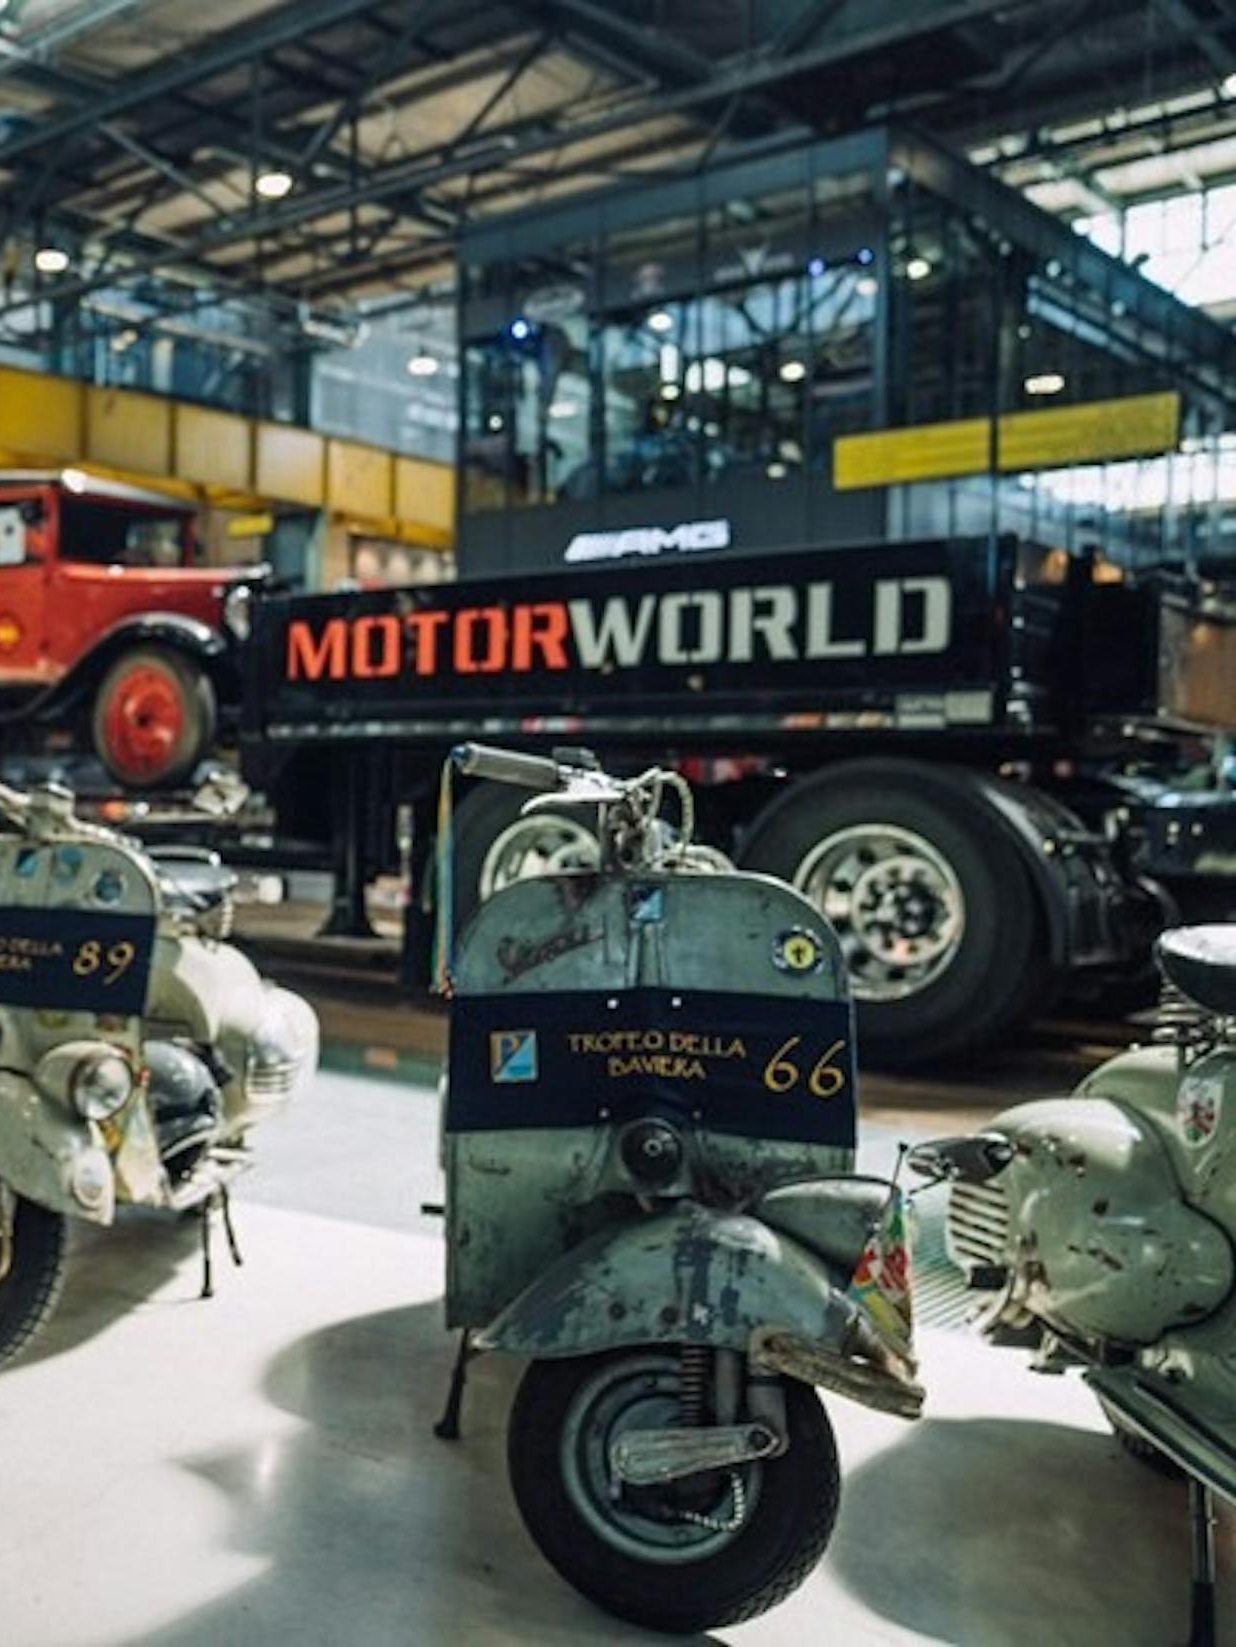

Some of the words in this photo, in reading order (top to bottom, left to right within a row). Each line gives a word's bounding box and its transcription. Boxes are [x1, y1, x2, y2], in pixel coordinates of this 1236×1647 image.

[72, 940, 136, 985] 89
[568, 1031, 664, 1052] TROFEO
[669, 1032, 746, 1058] DELLA
[609, 1056, 706, 1079] BAVIERA
[765, 1036, 846, 1097] 66
